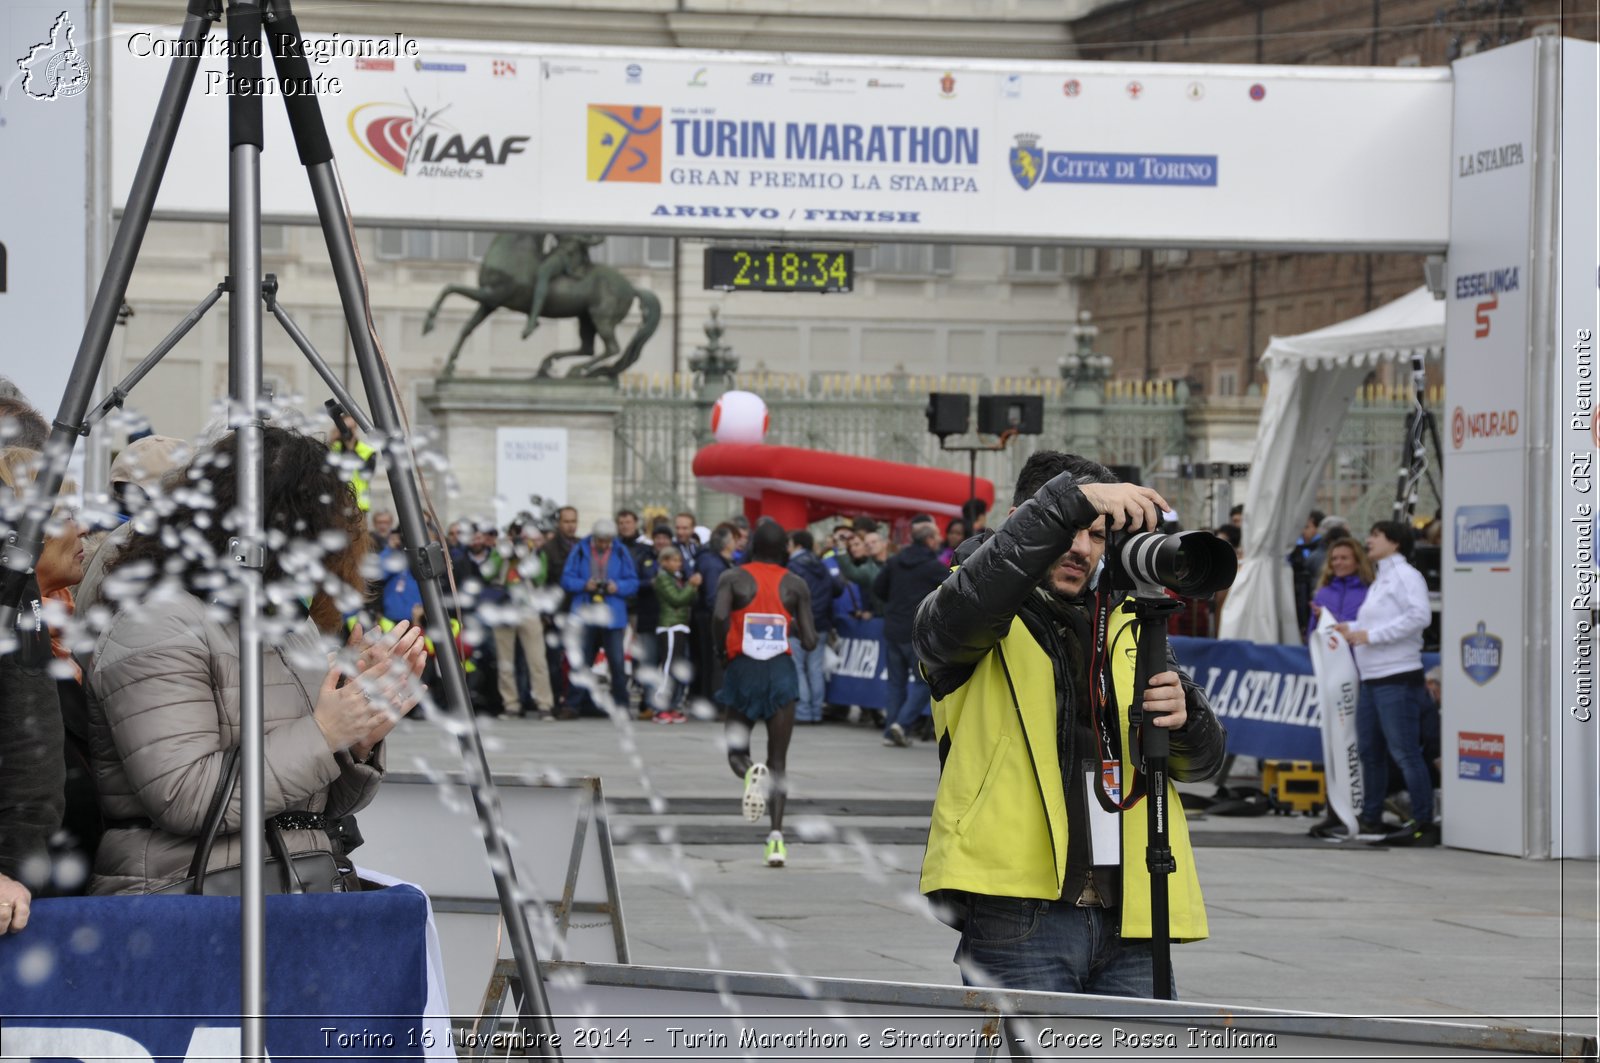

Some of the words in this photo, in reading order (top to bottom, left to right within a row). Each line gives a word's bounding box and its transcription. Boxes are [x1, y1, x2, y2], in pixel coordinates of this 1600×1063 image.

[421, 133, 531, 165] IAAF
[670, 118, 776, 159] TURIN
[785, 122, 979, 165] MARATHON
[418, 165, 484, 179] Athletics
[1459, 154, 1475, 178] LA
[1477, 142, 1524, 174] STAMPA
[670, 167, 740, 186] GRAN
[749, 170, 844, 190] PREMIO
[851, 173, 882, 191] LA
[889, 174, 979, 193] STAMPA
[651, 204, 780, 220] ARRIVO
[804, 209, 921, 223] FINISH
[733, 252, 847, 287] 2:18:34
[1456, 266, 1519, 300] ESSELUNGA
[764, 625, 774, 640] 2
[1096, 606, 1106, 653] Canon
[1464, 643, 1499, 668] Bavaria
[1206, 667, 1238, 716] LA
